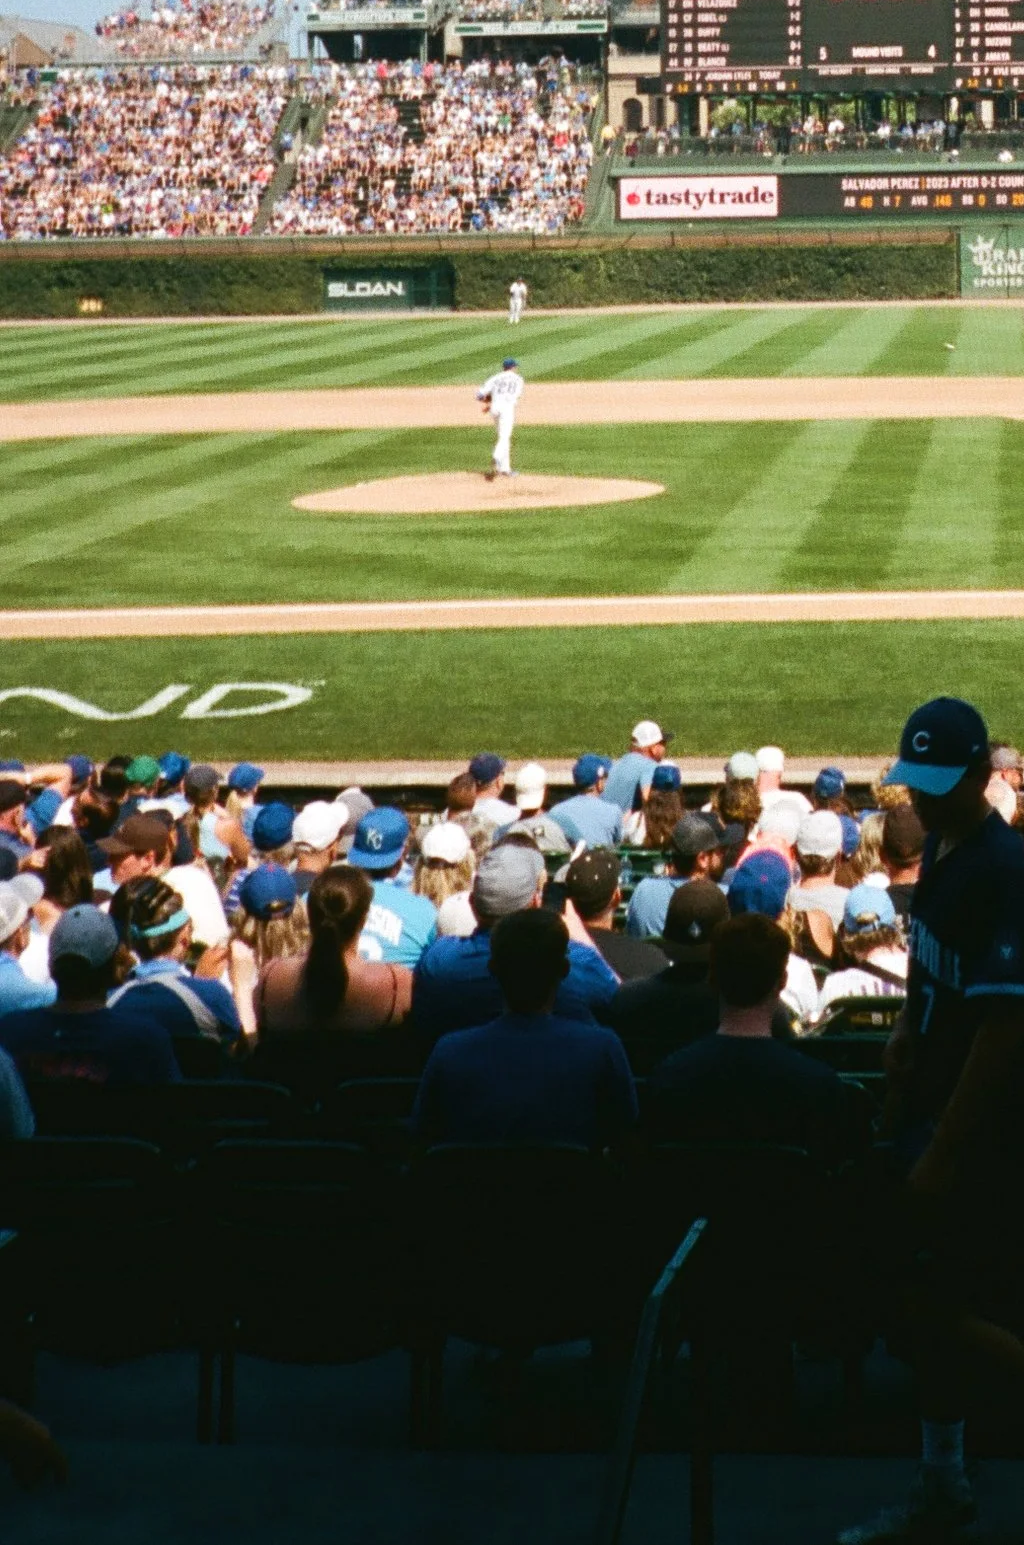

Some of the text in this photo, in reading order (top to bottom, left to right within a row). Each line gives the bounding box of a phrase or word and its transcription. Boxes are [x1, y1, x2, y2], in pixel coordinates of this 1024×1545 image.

[820, 46, 827, 61] 5
[928, 44, 936, 58] 4
[841, 177, 889, 190] SALVADOR
[891, 177, 919, 189] PEREZ
[926, 176, 949, 189] 2023
[951, 176, 979, 188] AFTER
[981, 175, 996, 188] 0-2
[645, 186, 774, 210] tastytrade
[328, 281, 406, 297] SLOAN
[912, 731, 930, 752] C
